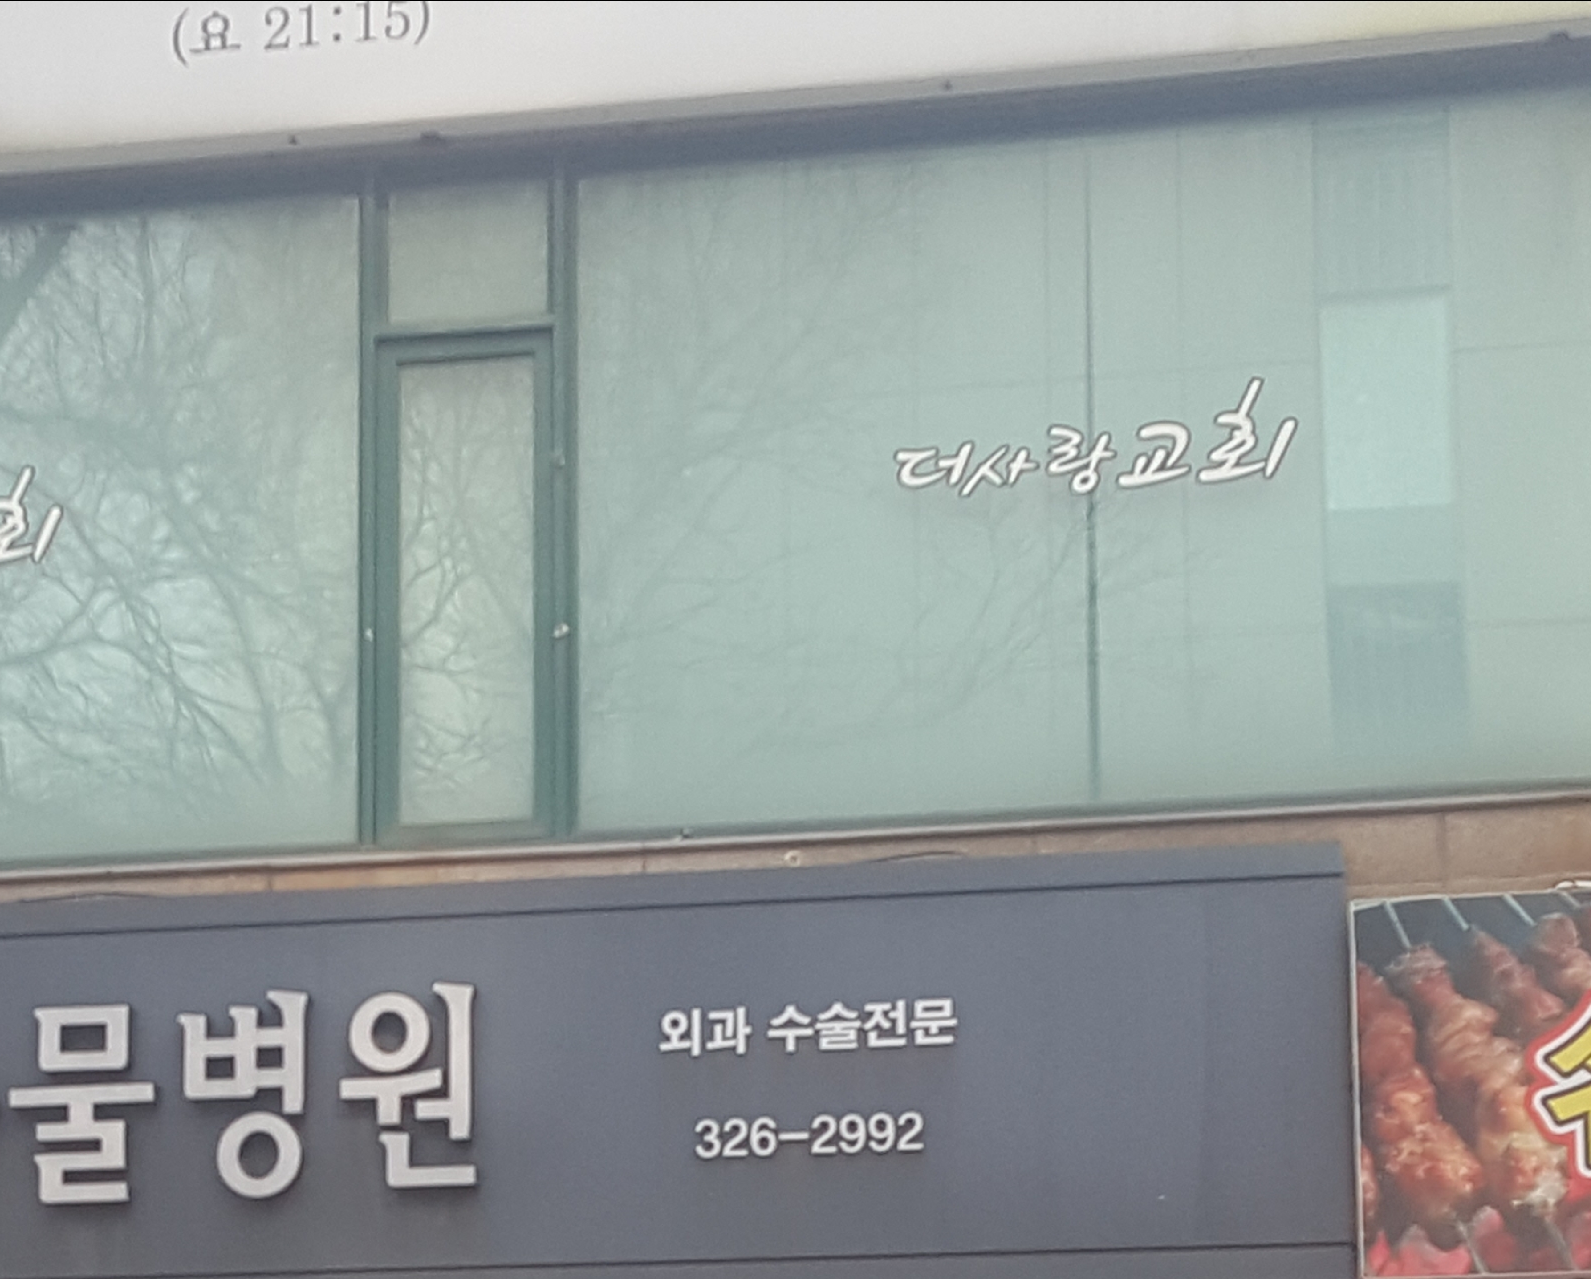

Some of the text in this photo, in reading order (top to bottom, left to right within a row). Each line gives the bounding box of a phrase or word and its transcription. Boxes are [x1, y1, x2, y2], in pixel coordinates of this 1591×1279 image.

[172, 0, 429, 68] (요 21:15)
[893, 376, 1298, 497] 더사랑교회
[658, 997, 958, 1057] 외과 수술전문
[693, 1110, 925, 1159] 326-2992
